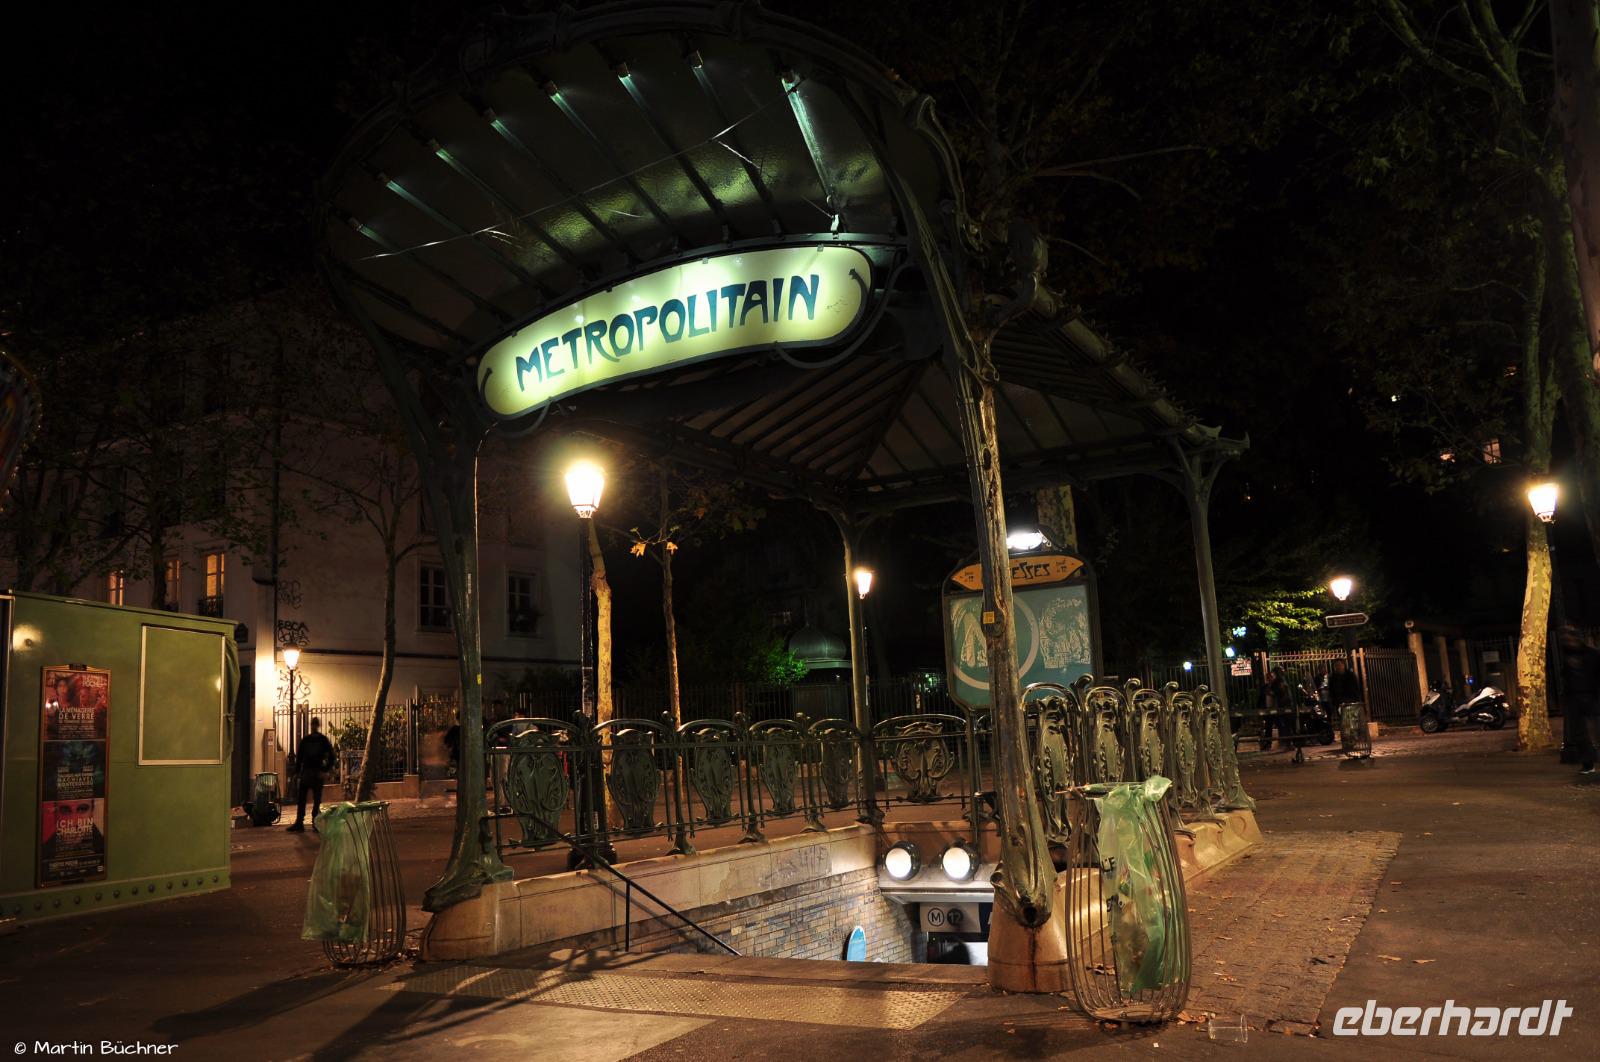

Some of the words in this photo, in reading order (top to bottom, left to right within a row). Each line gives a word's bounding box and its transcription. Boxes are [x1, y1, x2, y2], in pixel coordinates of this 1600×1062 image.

[515, 273, 820, 392] METROPOLITAIN
[56, 818, 74, 829] ICH
[77, 816, 94, 827] BIN
